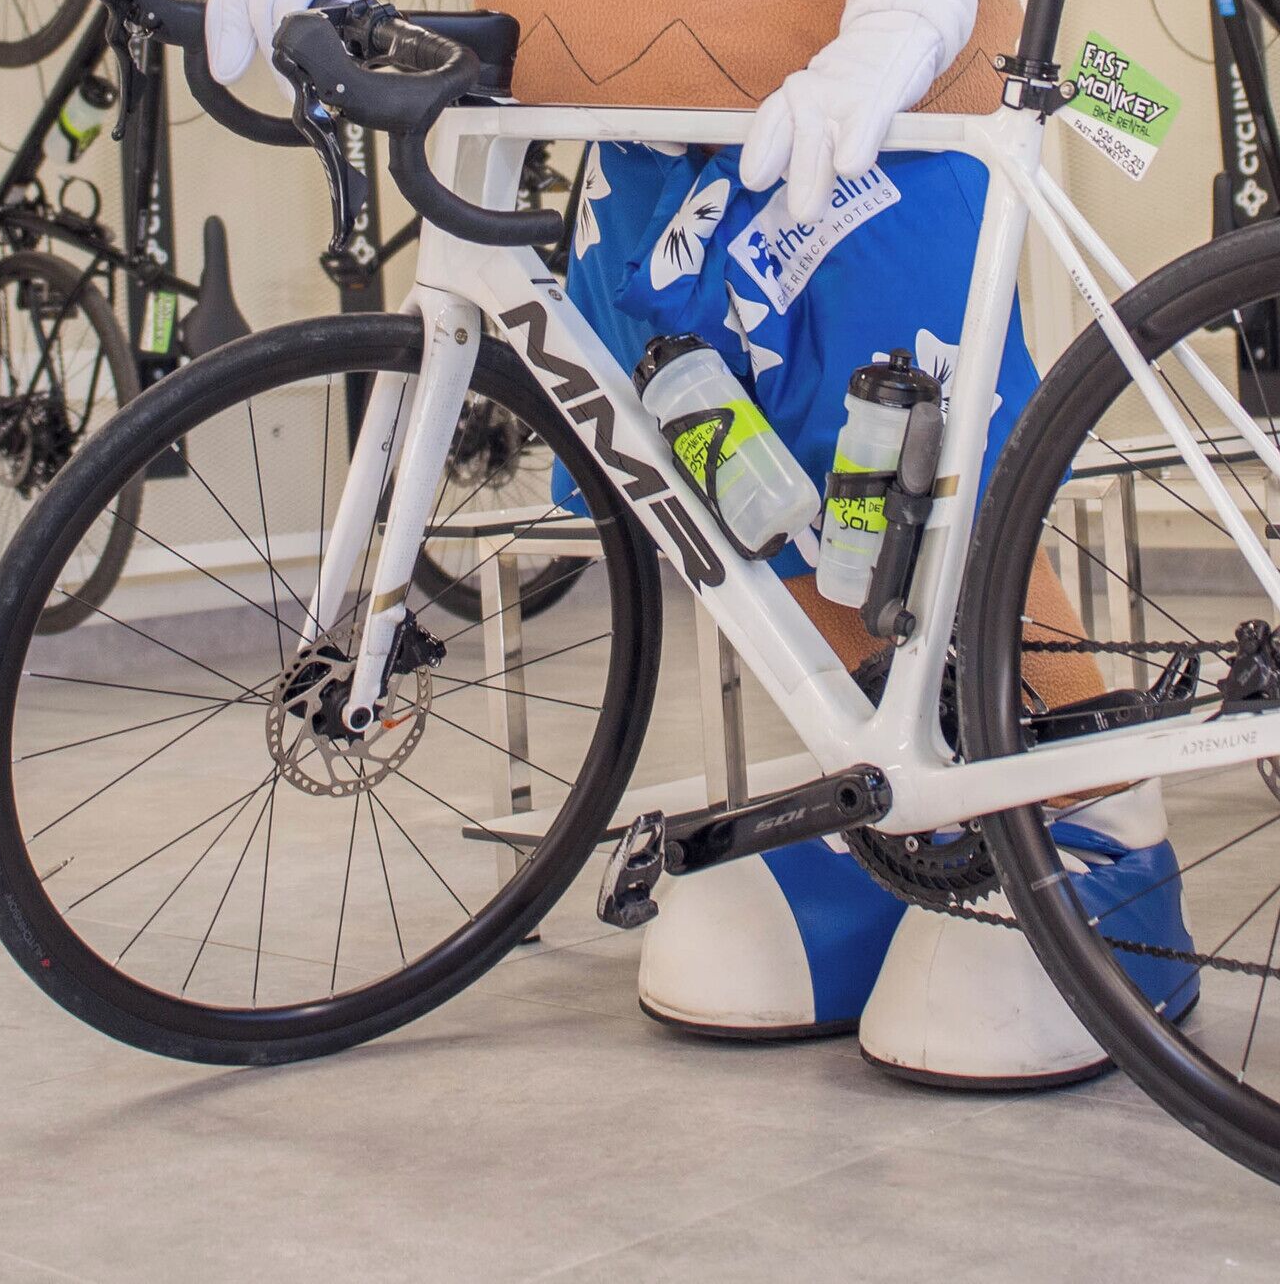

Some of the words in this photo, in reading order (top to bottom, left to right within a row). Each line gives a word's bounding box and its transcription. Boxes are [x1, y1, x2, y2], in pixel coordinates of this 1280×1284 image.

[1080, 41, 1130, 80] FAST
[1075, 71, 1169, 124] MONKEY
[1097, 126, 1114, 144] 626
[1113, 139, 1132, 159] 005
[1130, 154, 1146, 171] 213
[831, 187, 893, 234] HOTELS
[775, 221, 816, 261] the
[497, 300, 727, 597] MMR
[839, 509, 879, 534] SOL
